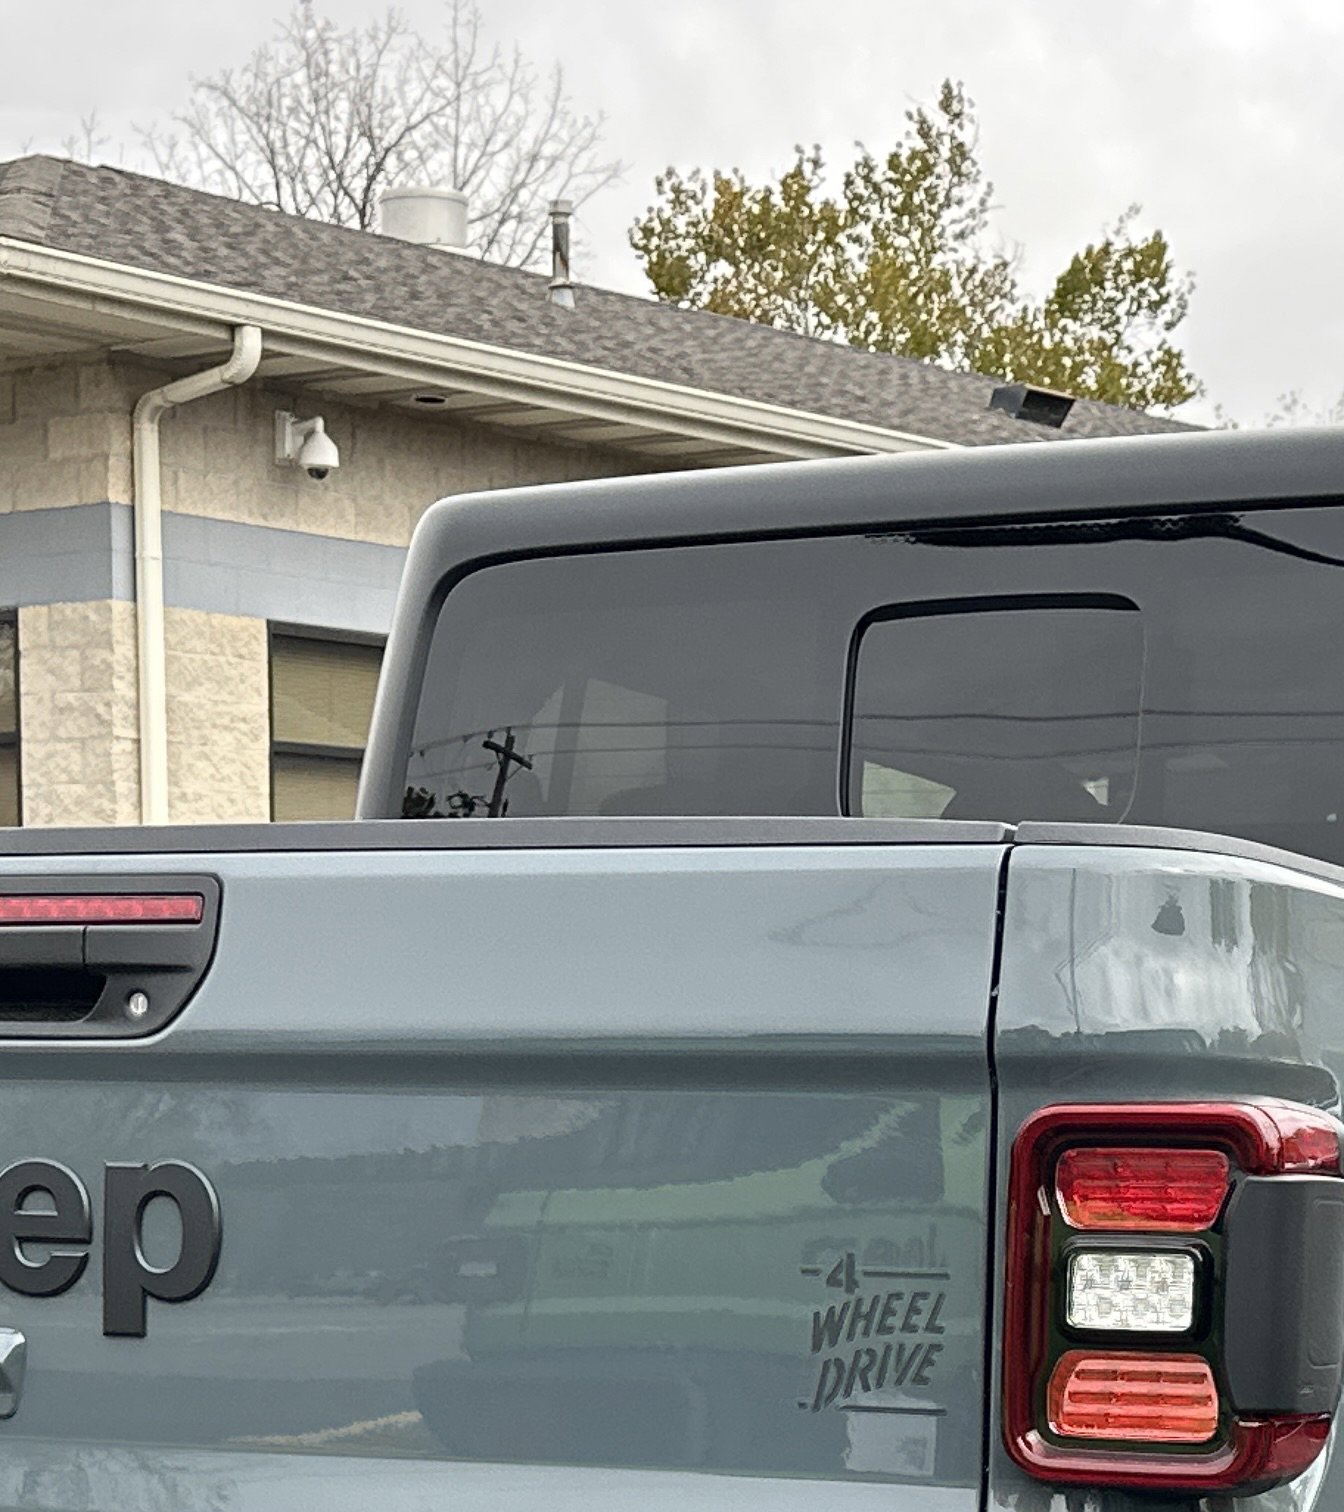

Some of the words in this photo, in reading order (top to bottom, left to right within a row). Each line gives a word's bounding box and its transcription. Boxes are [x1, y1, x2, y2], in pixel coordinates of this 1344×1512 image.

[825, 1252, 860, 1295] 4
[811, 1291, 946, 1354] WHEEL
[811, 1343, 944, 1413] DRIVE
